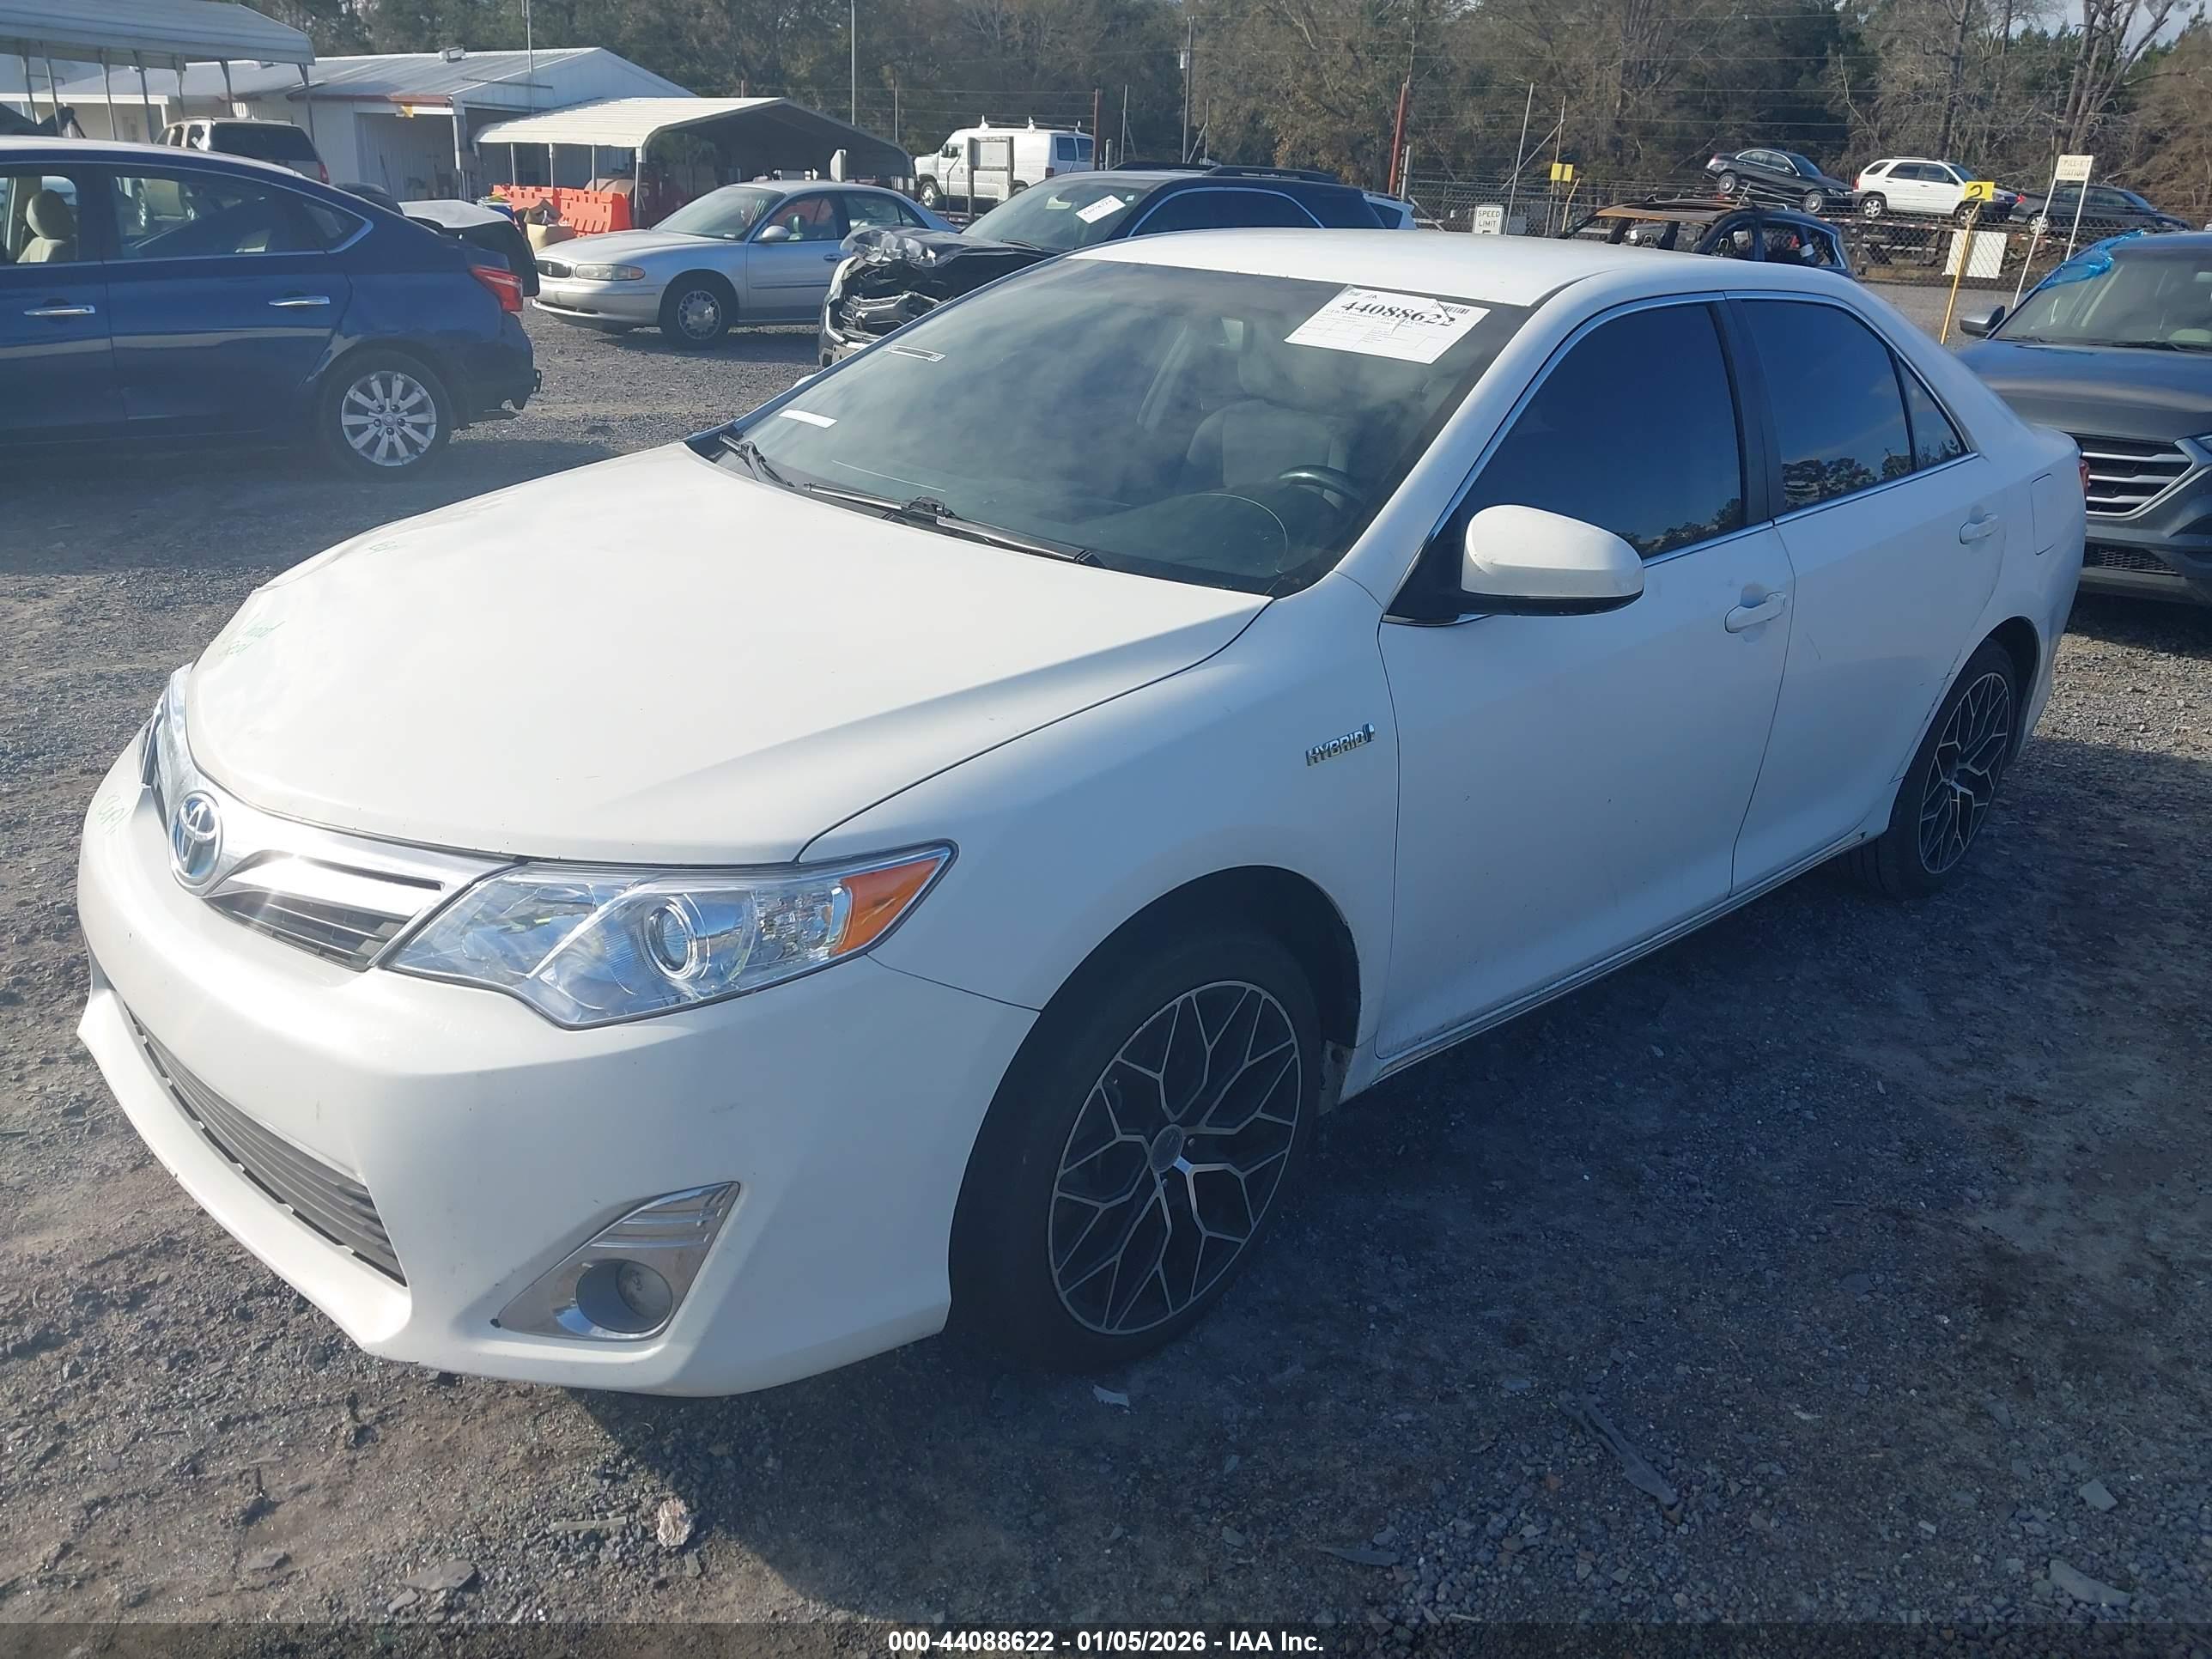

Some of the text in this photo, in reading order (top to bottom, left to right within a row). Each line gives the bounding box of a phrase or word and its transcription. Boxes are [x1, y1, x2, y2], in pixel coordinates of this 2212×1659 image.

[1966, 185, 1985, 201] 2
[1340, 301, 1456, 327] 44088622
[1305, 729, 1366, 766] HYBRID
